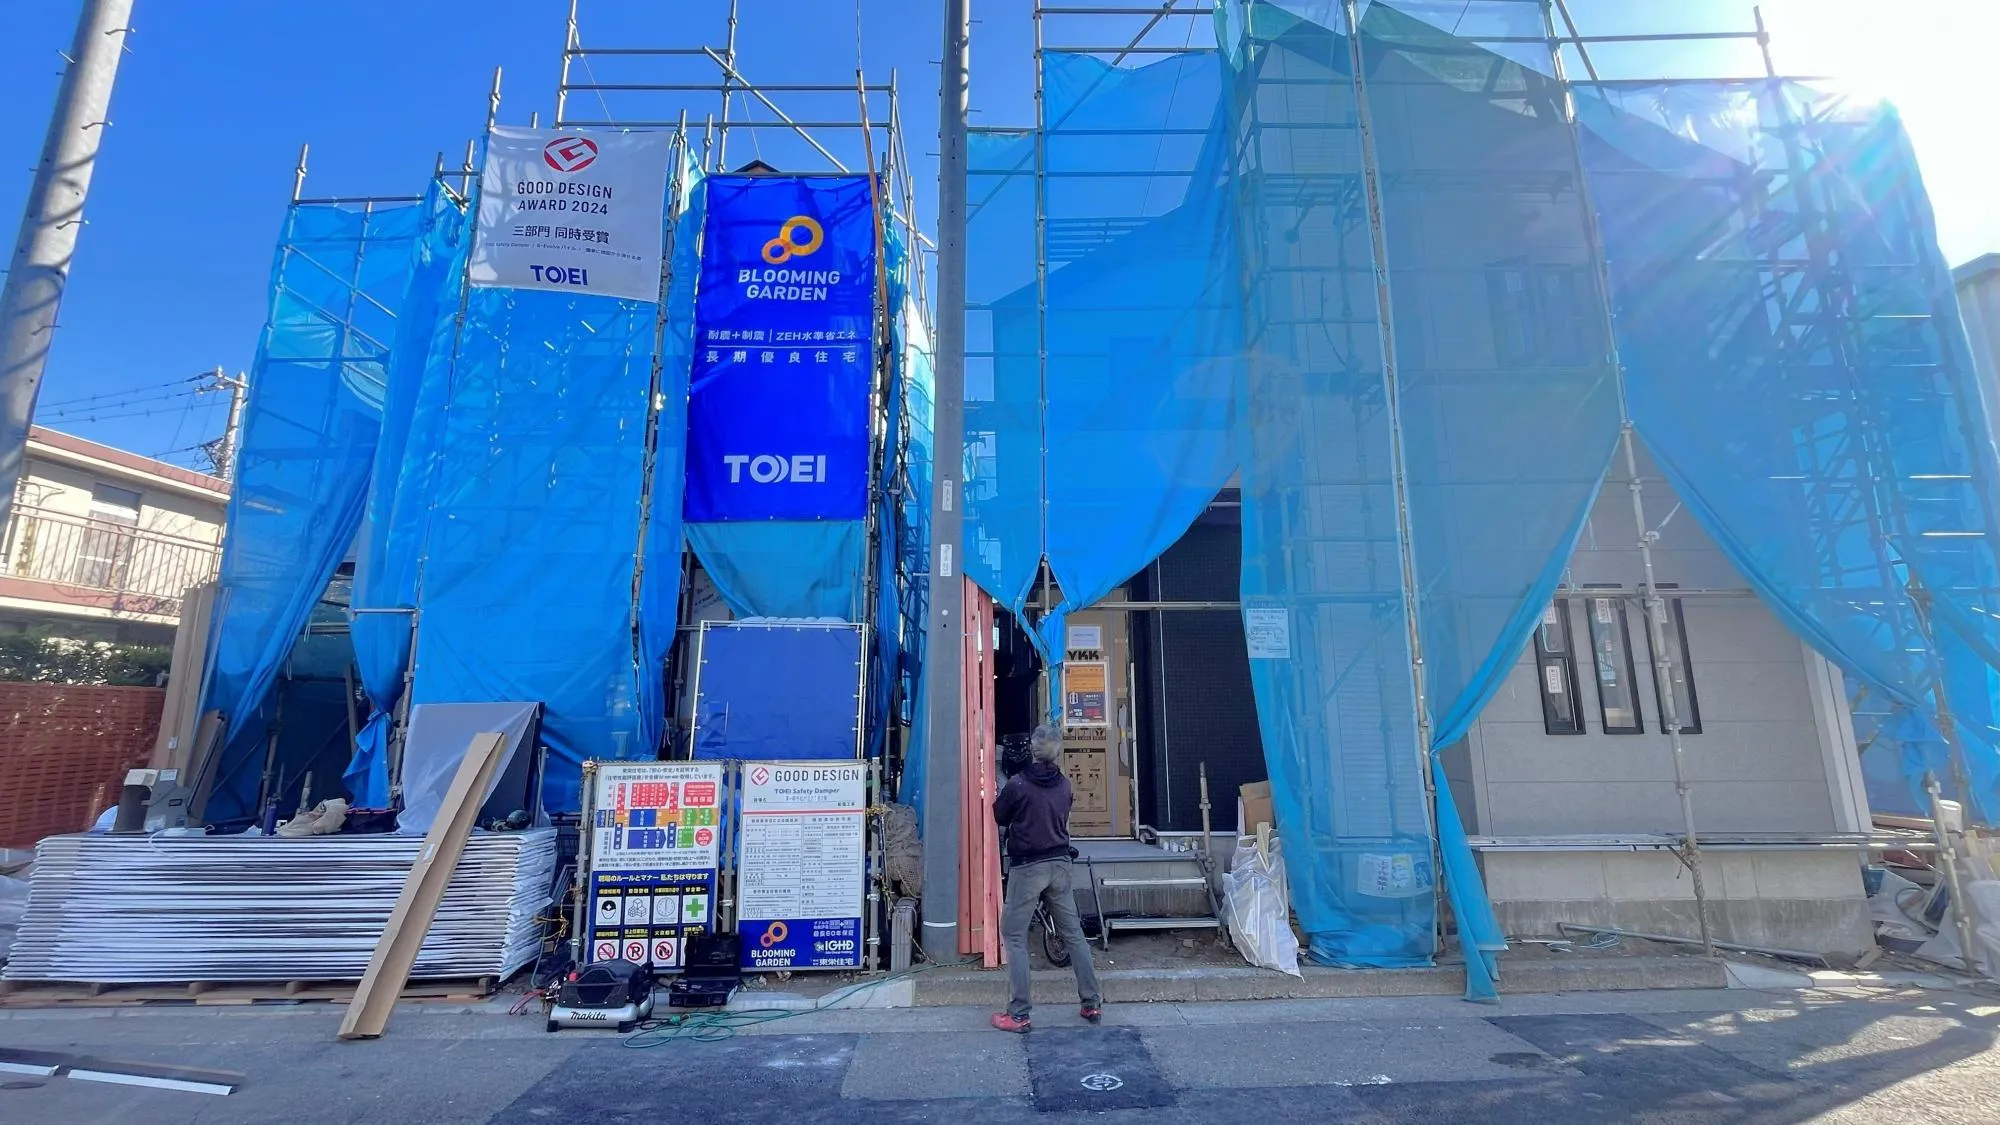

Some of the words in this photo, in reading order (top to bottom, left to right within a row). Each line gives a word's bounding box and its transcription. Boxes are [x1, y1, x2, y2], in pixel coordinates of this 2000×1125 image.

[517, 181, 554, 195] GOOD
[558, 182, 612, 199] DESIGN
[518, 199, 567, 212] AWARD
[572, 200, 609, 215] 2024
[512, 225, 550, 238] 三部門
[555, 226, 610, 244] 同時受賞
[530, 265, 588, 286] TOEI
[738, 269, 840, 285] BLOOMING
[746, 284, 827, 301] GARDEN
[723, 454, 827, 483] TOEI
[775, 770, 809, 782] GOOD
[813, 769, 859, 781] DESIGN
[751, 949, 796, 958] BLOOMING
[825, 940, 854, 951] IGHD
[755, 958, 791, 967] GARDEN
